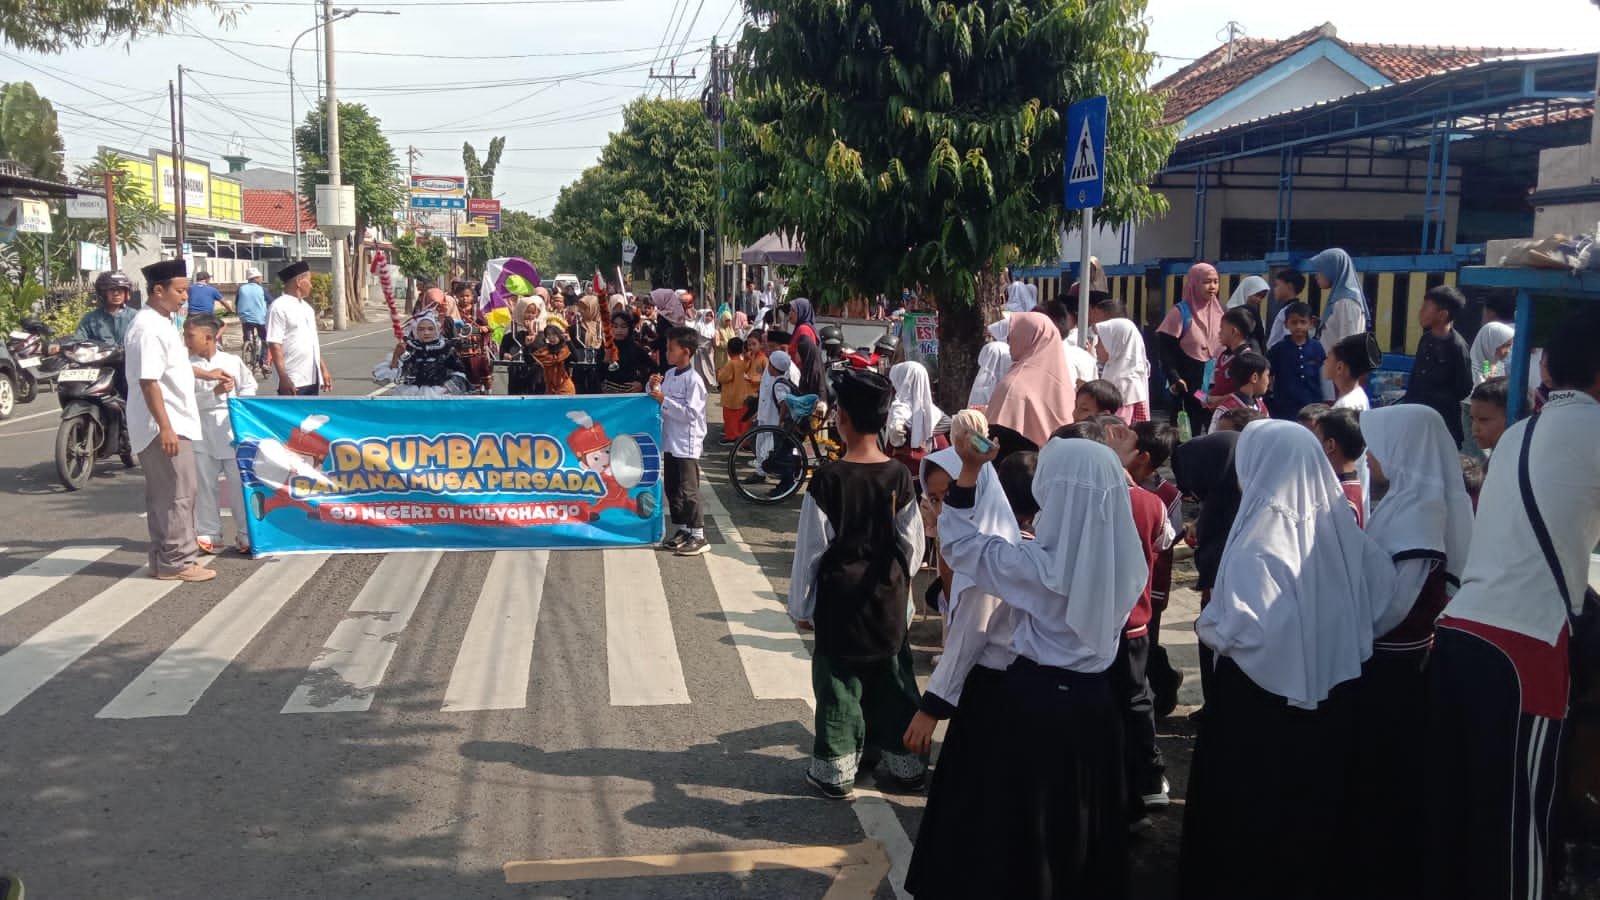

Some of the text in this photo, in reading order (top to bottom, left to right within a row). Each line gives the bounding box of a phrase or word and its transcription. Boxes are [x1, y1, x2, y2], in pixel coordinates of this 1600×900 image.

[335, 438, 559, 472] DRUMBAND
[295, 471, 601, 496] BAHANA MUSA PERSADA
[330, 504, 580, 521] SD NEGERI 01 MULYOHARJO
